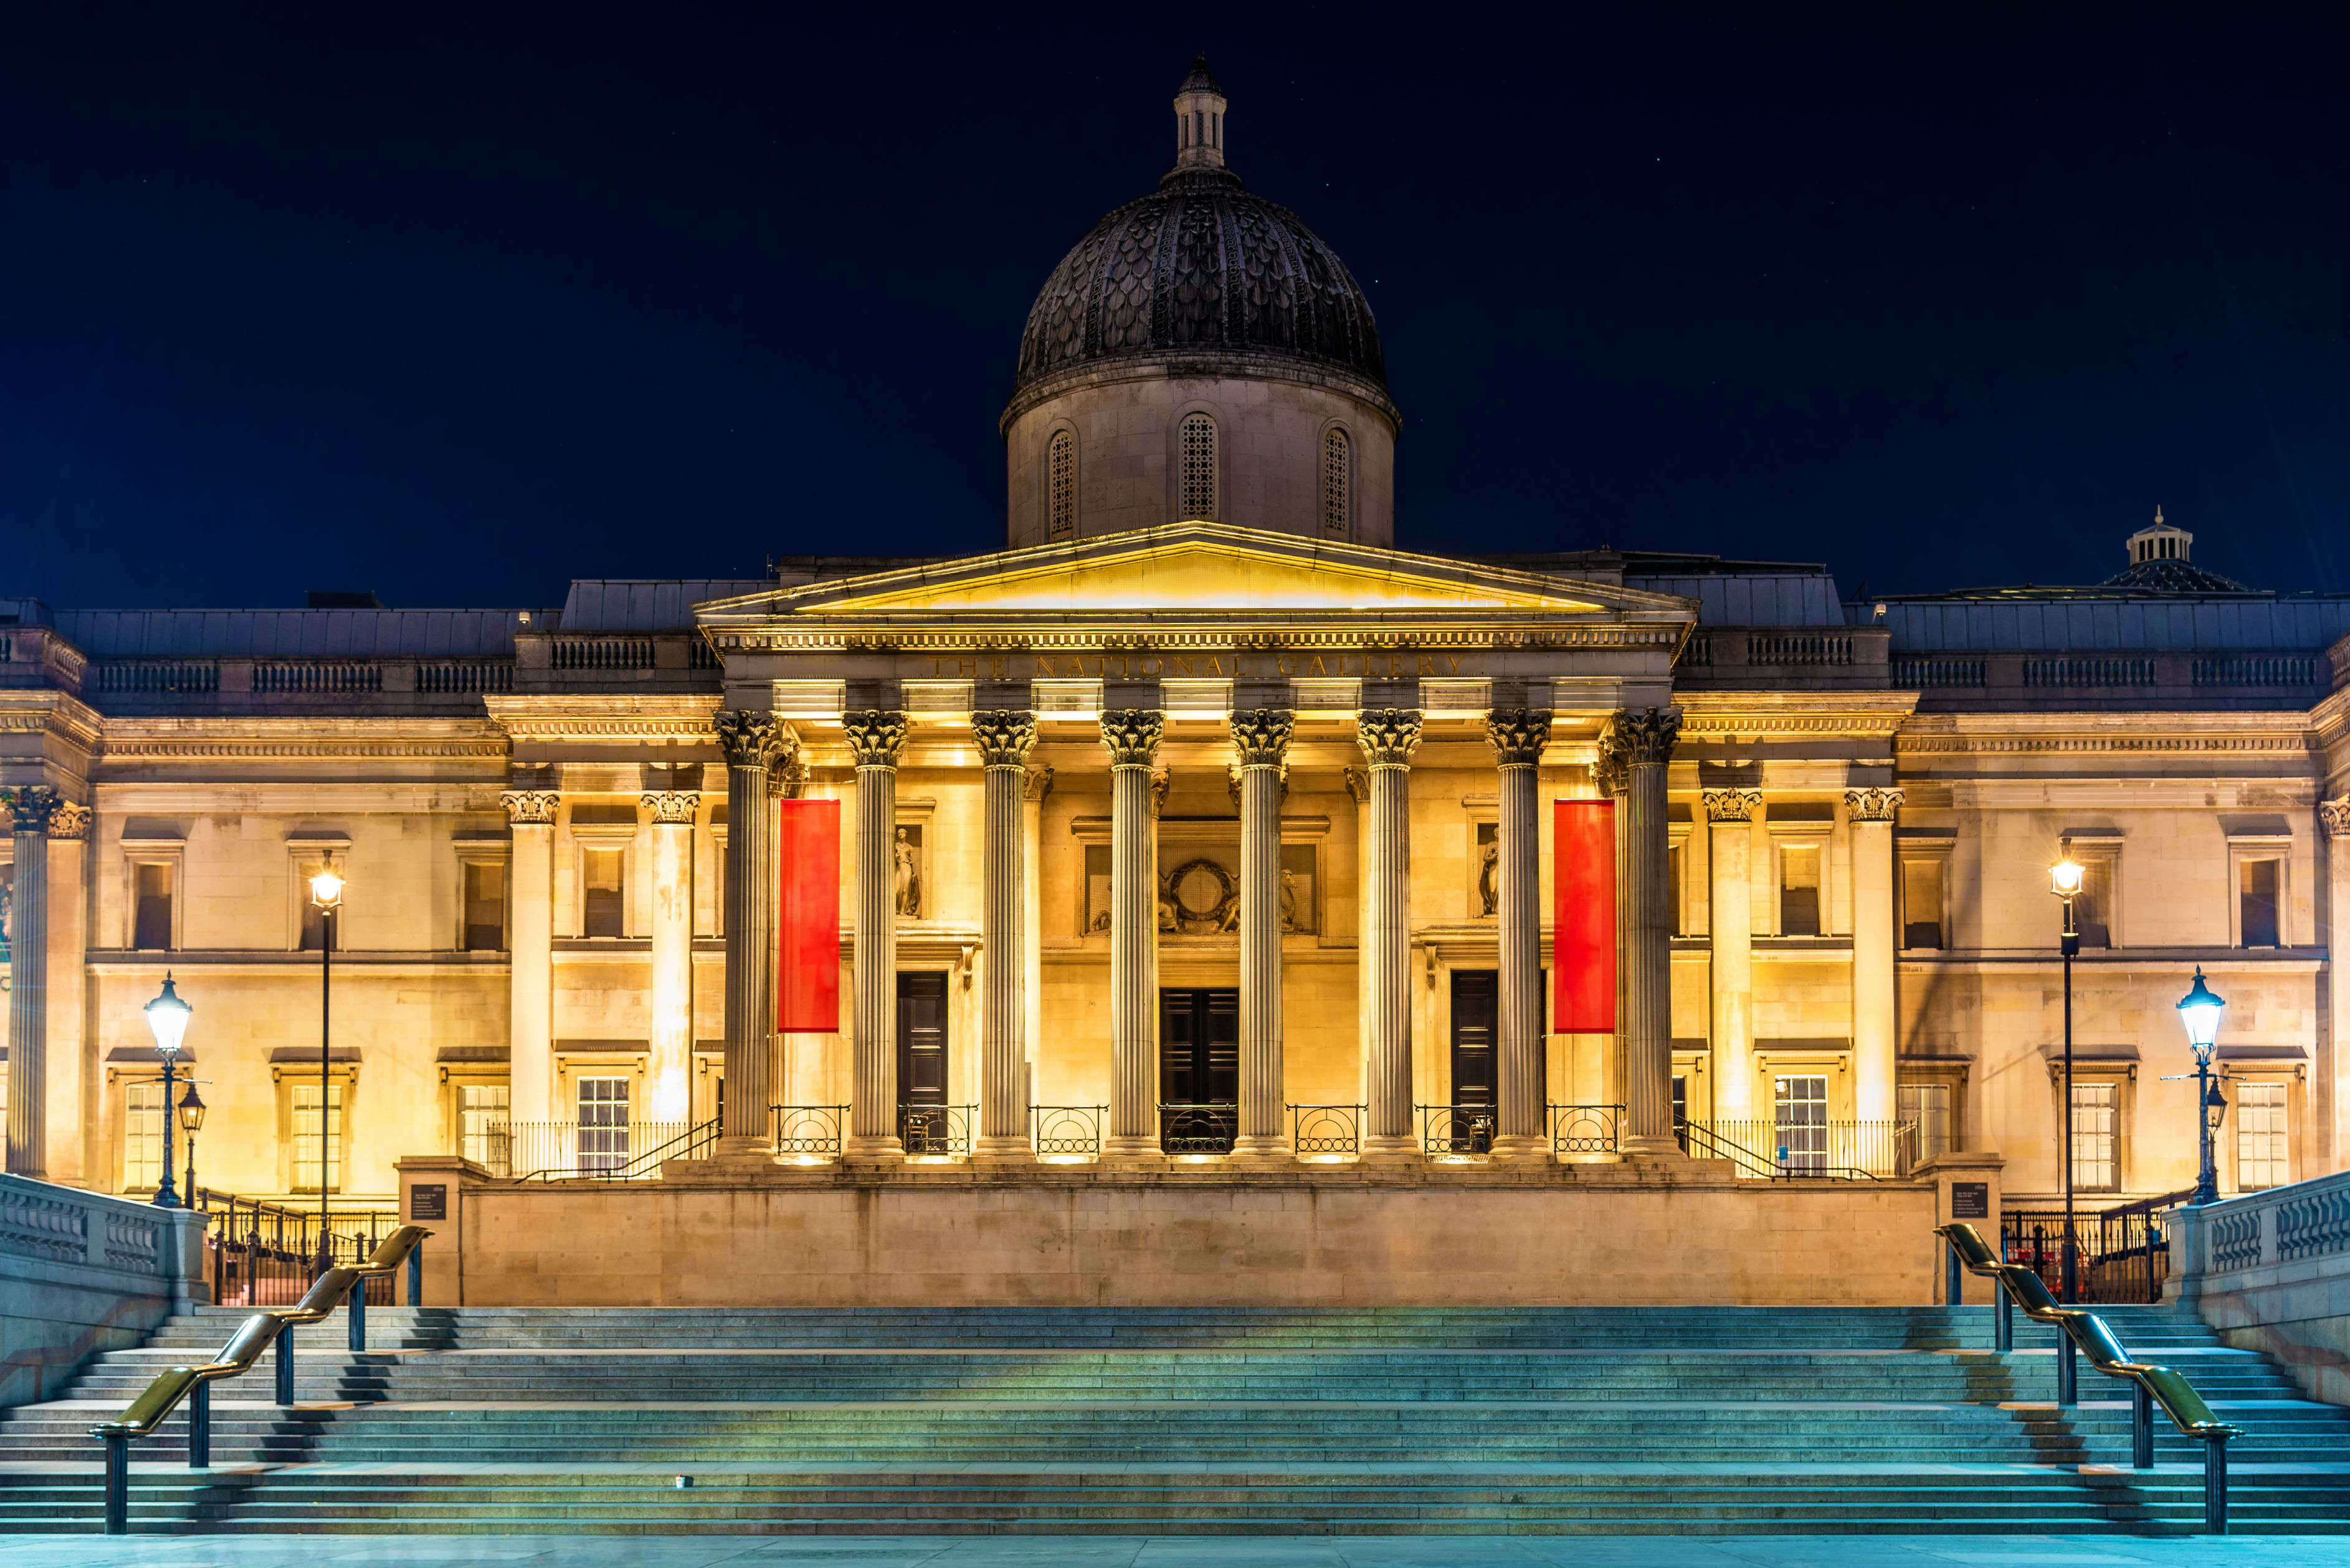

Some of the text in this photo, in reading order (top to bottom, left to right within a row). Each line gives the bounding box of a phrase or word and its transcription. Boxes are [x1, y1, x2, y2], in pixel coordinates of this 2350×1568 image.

[927, 655, 1464, 678] THE NATIONAL GALLERY
